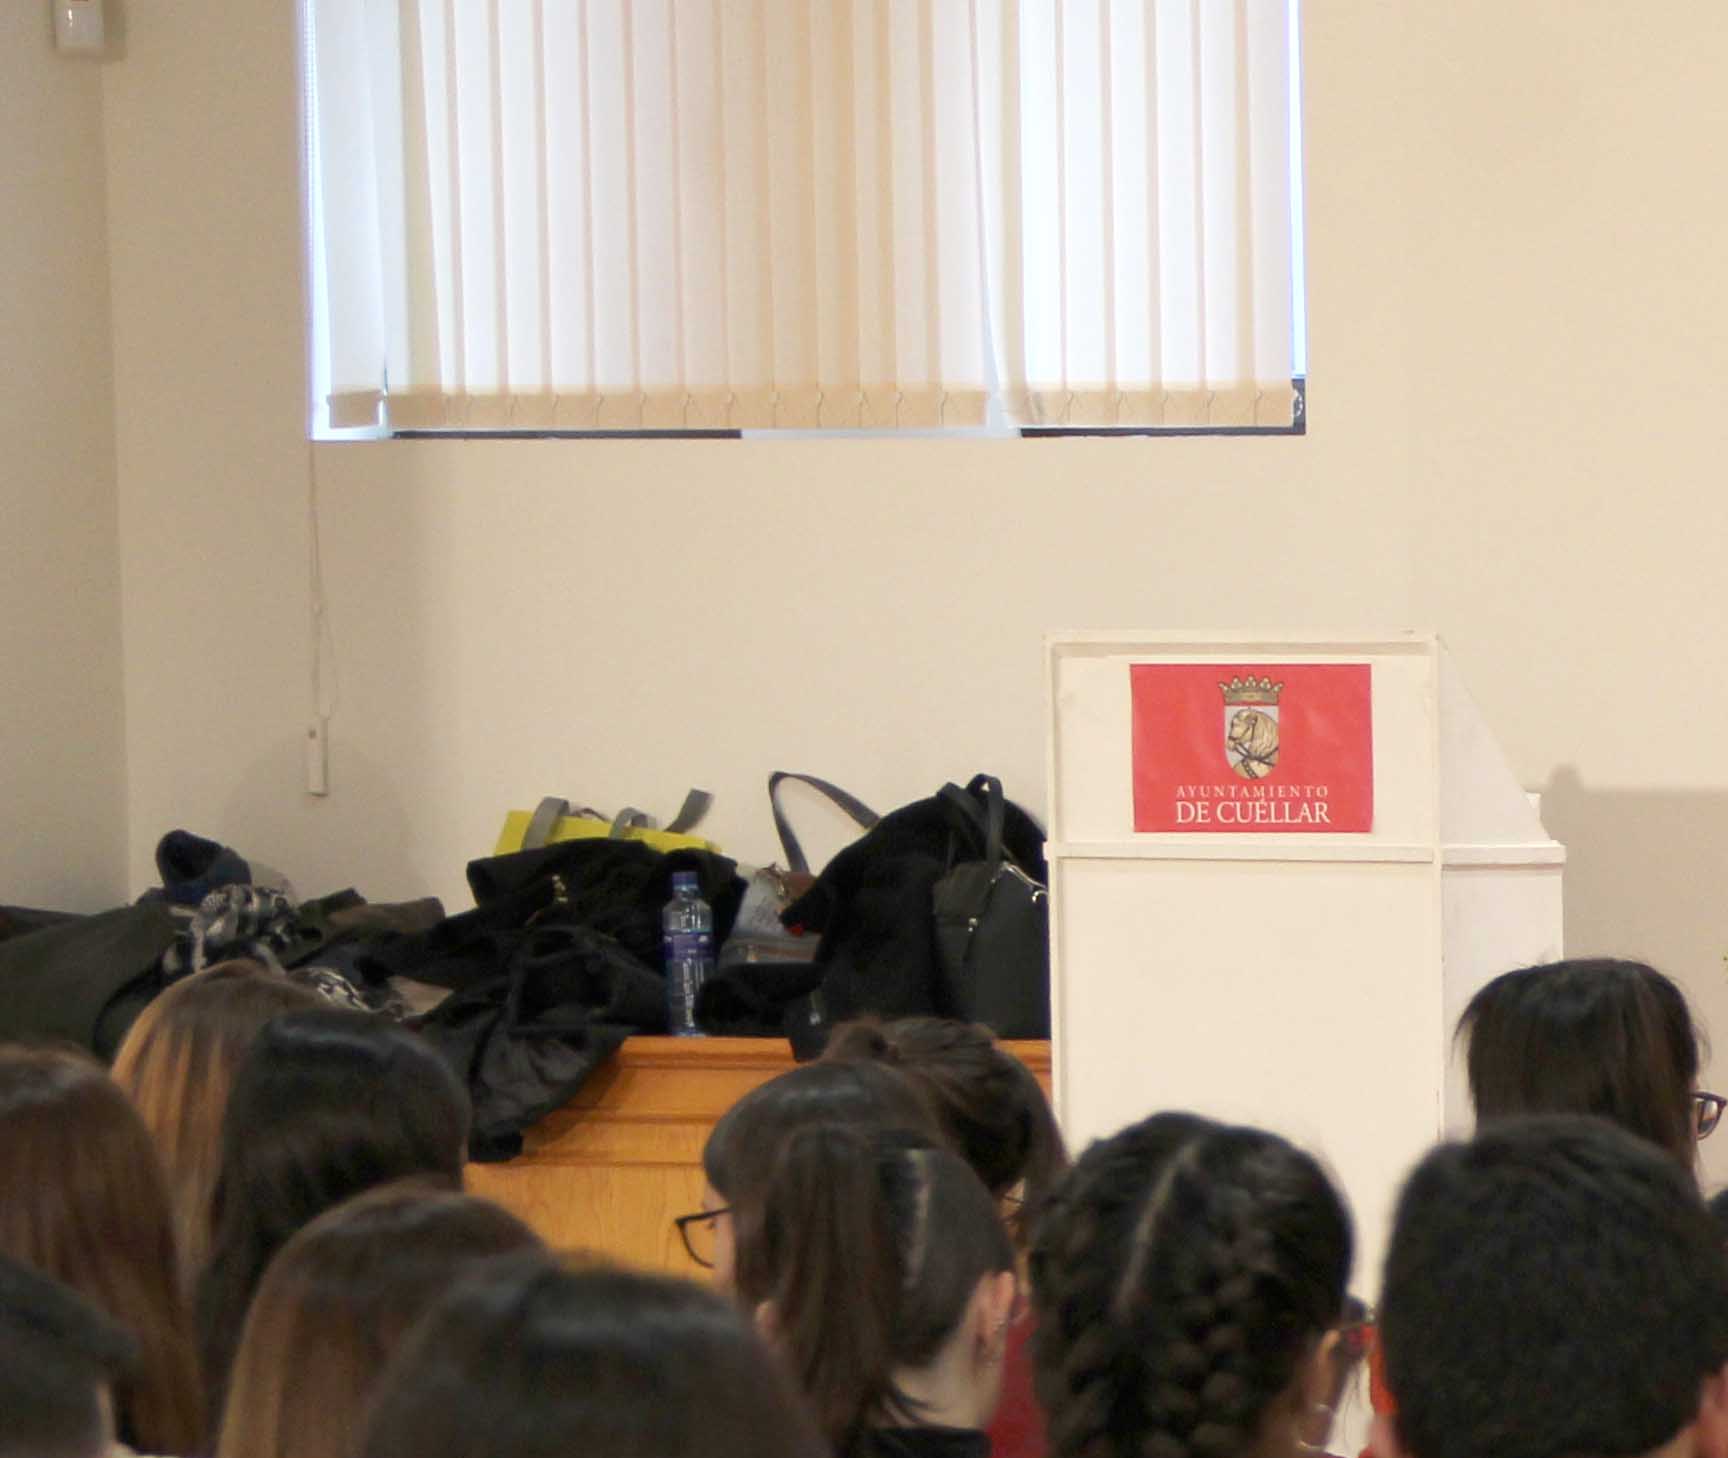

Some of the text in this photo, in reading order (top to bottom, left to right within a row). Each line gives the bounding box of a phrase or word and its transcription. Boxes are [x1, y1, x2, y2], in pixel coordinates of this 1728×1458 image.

[1176, 784, 1329, 799] AYUNTAMIENTO
[1175, 798, 1331, 824] DE CUÉLLAR
